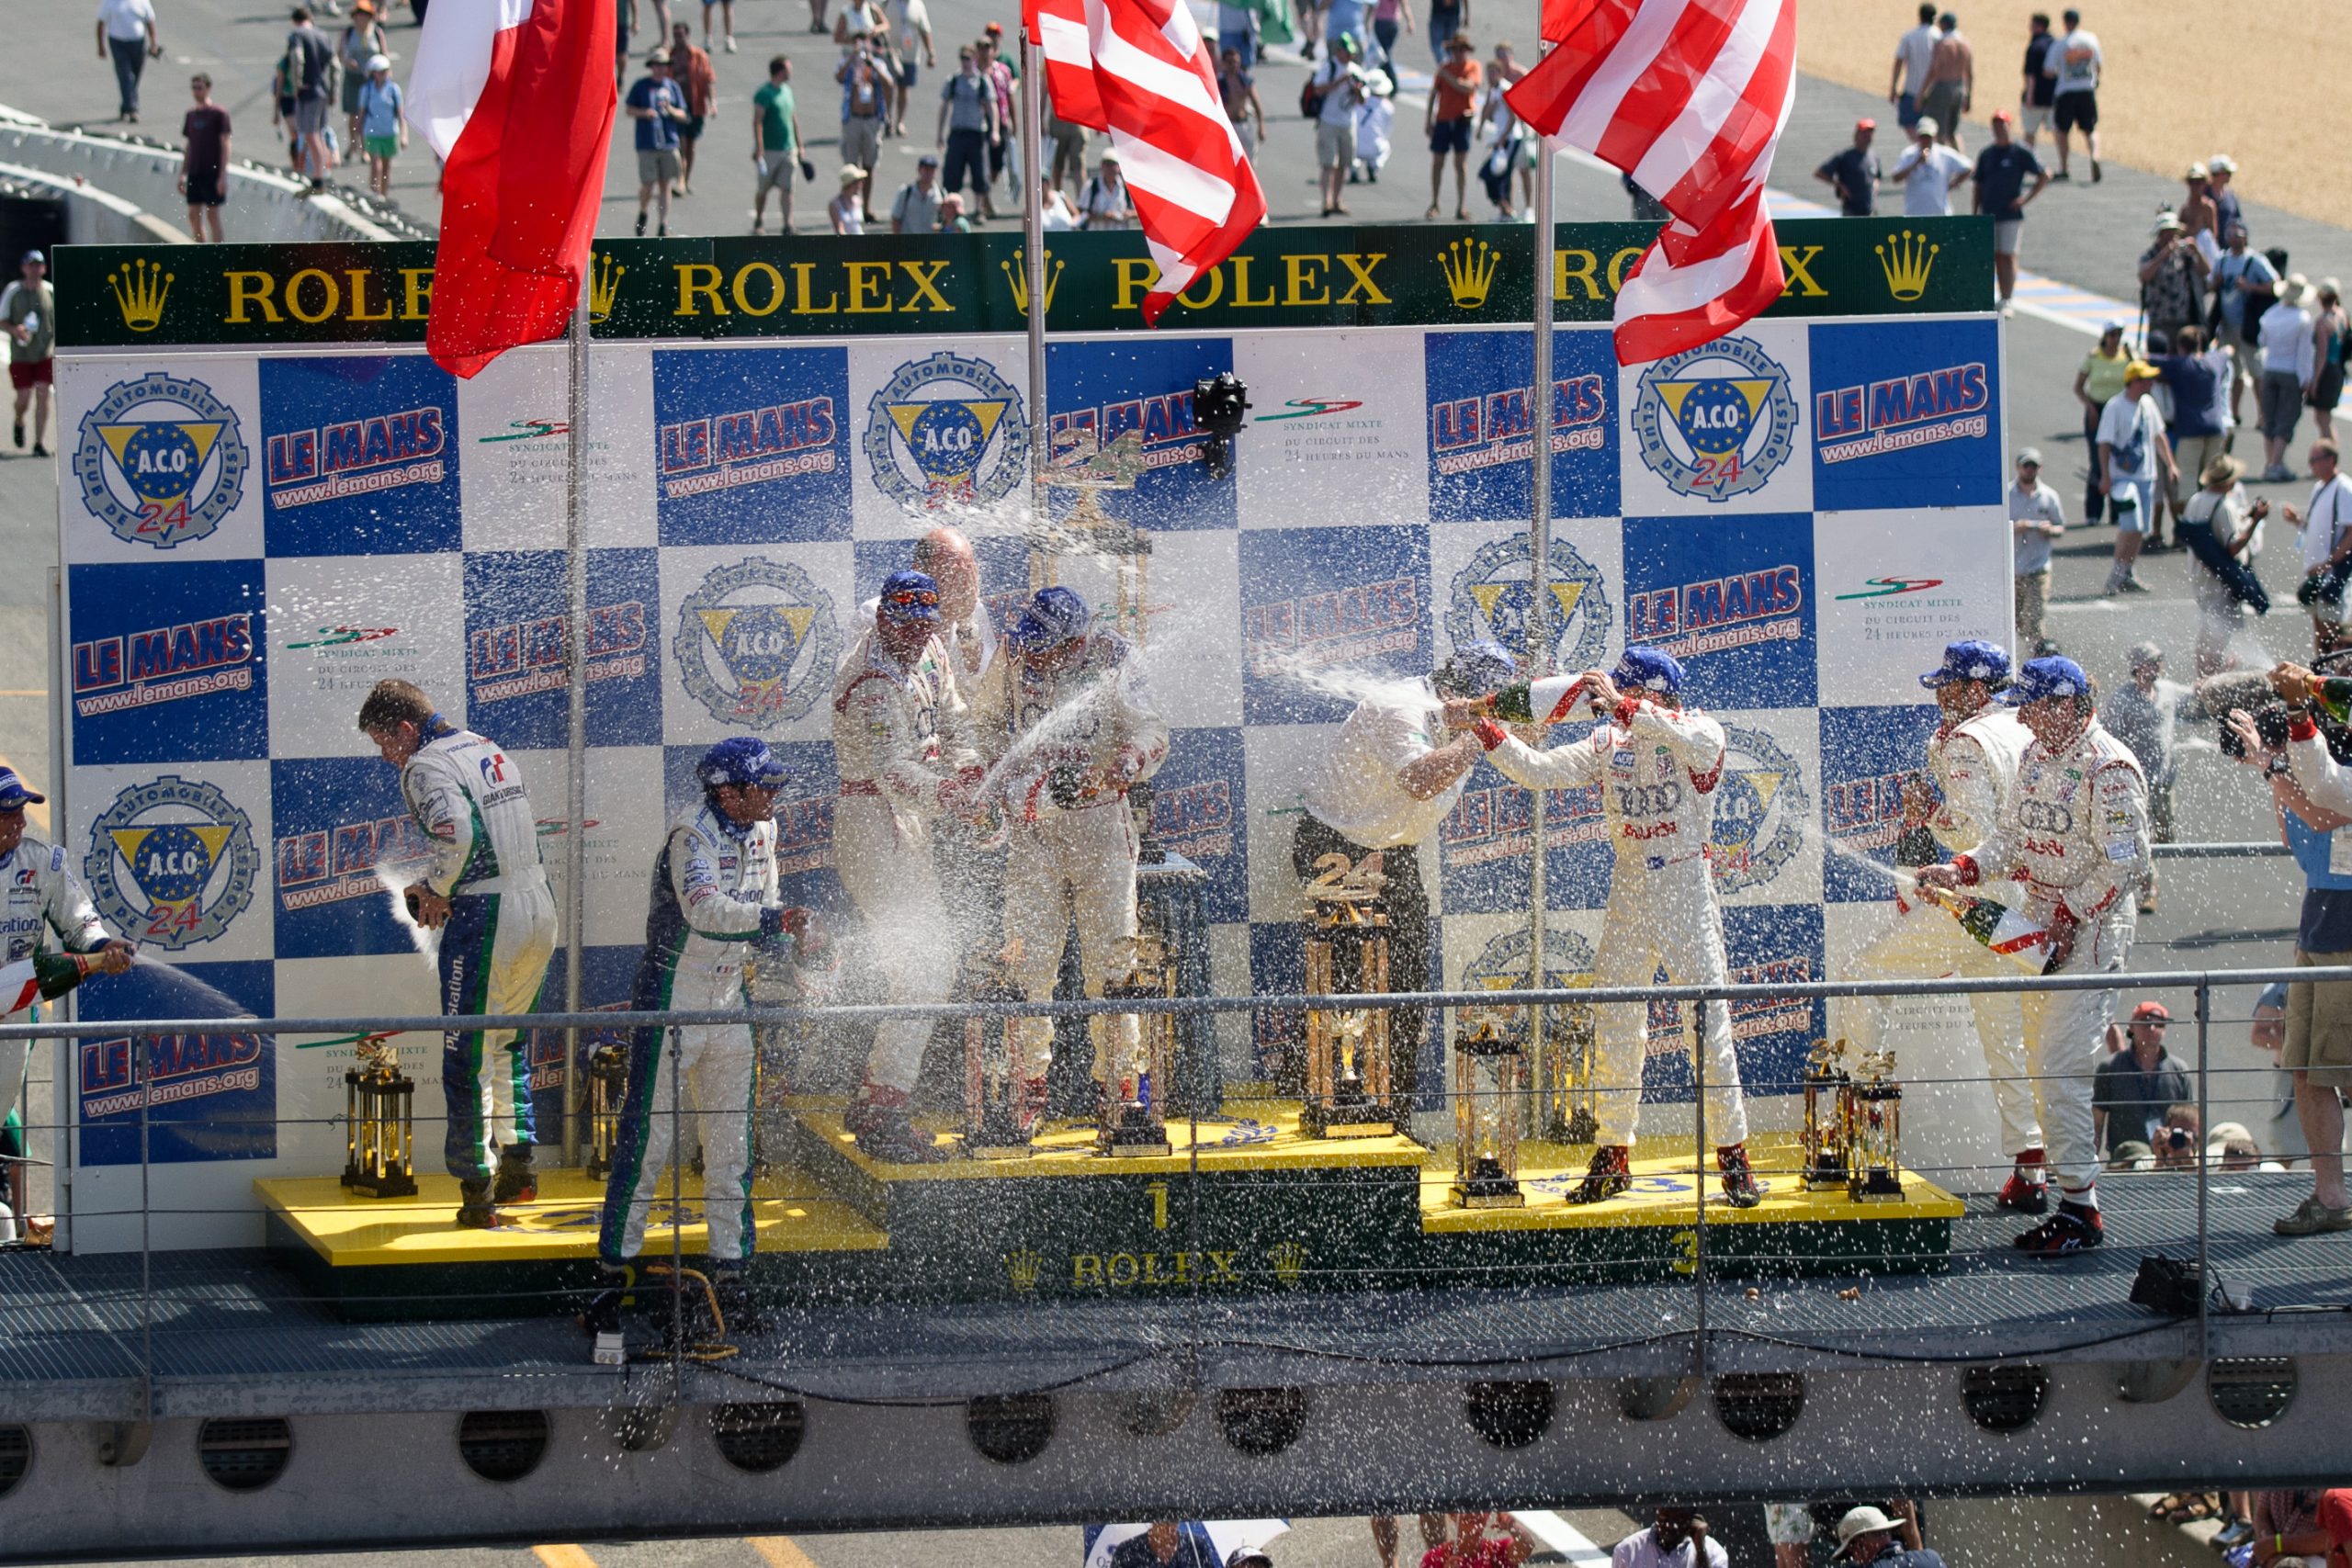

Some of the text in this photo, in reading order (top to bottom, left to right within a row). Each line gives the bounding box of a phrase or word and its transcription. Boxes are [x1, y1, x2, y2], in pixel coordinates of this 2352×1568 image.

[223, 268, 435, 323] ROLE
[673, 261, 956, 317] ROLEX
[1111, 254, 1393, 310] ROLEX
[104, 384, 217, 419] AUTOMOBILE
[892, 364, 1000, 398] AUTOMOBILE
[1816, 363, 1988, 441] LE MANS
[662, 397, 835, 474] LE MANS
[1283, 421, 1383, 431] SYNDICAT MIXTE
[1433, 397, 1481, 452] LE
[1643, 398, 1788, 479] CLUB DE L'OUEST
[1693, 404, 1739, 428] A.C.O
[1819, 415, 1986, 464] www.lemans.org
[268, 407, 445, 486] LE MANS
[1284, 450, 1300, 461] 24
[1306, 454, 1351, 462] HEURES
[1377, 451, 1409, 459] MANS
[1306, 437, 1354, 446] CIRCUIT
[1359, 436, 1380, 445] DES
[85, 441, 239, 525] CLUB DE L'OUEST
[272, 460, 443, 509] www.lemans.org
[666, 450, 834, 498] www.lemans.org
[1691, 455, 1743, 487] 24
[137, 501, 192, 533] 24
[1631, 587, 1679, 642] LE
[1682, 565, 1802, 632] MANS
[1864, 599, 1962, 609] SYNDICAT MIXTE
[1865, 615, 1961, 625] DU CIRCUIT DES
[73, 614, 253, 694] LE MANS
[471, 624, 521, 680] LE
[1864, 627, 1881, 640] 24
[1886, 630, 1931, 639] HEURES
[1936, 629, 1952, 637] DU
[76, 667, 252, 716] www.lemans.org
[319, 665, 334, 673] DU
[319, 678, 335, 689] 24
[116, 787, 229, 822] AUTOMOBILE
[279, 830, 329, 887] LE
[147, 902, 202, 936] 24
[81, 1037, 132, 1094] LE
[326, 1077, 343, 1089] 24
[1146, 1181, 1169, 1230] 1
[1070, 1251, 1240, 1287] ROLEX
[1670, 1230, 1699, 1274] 3
